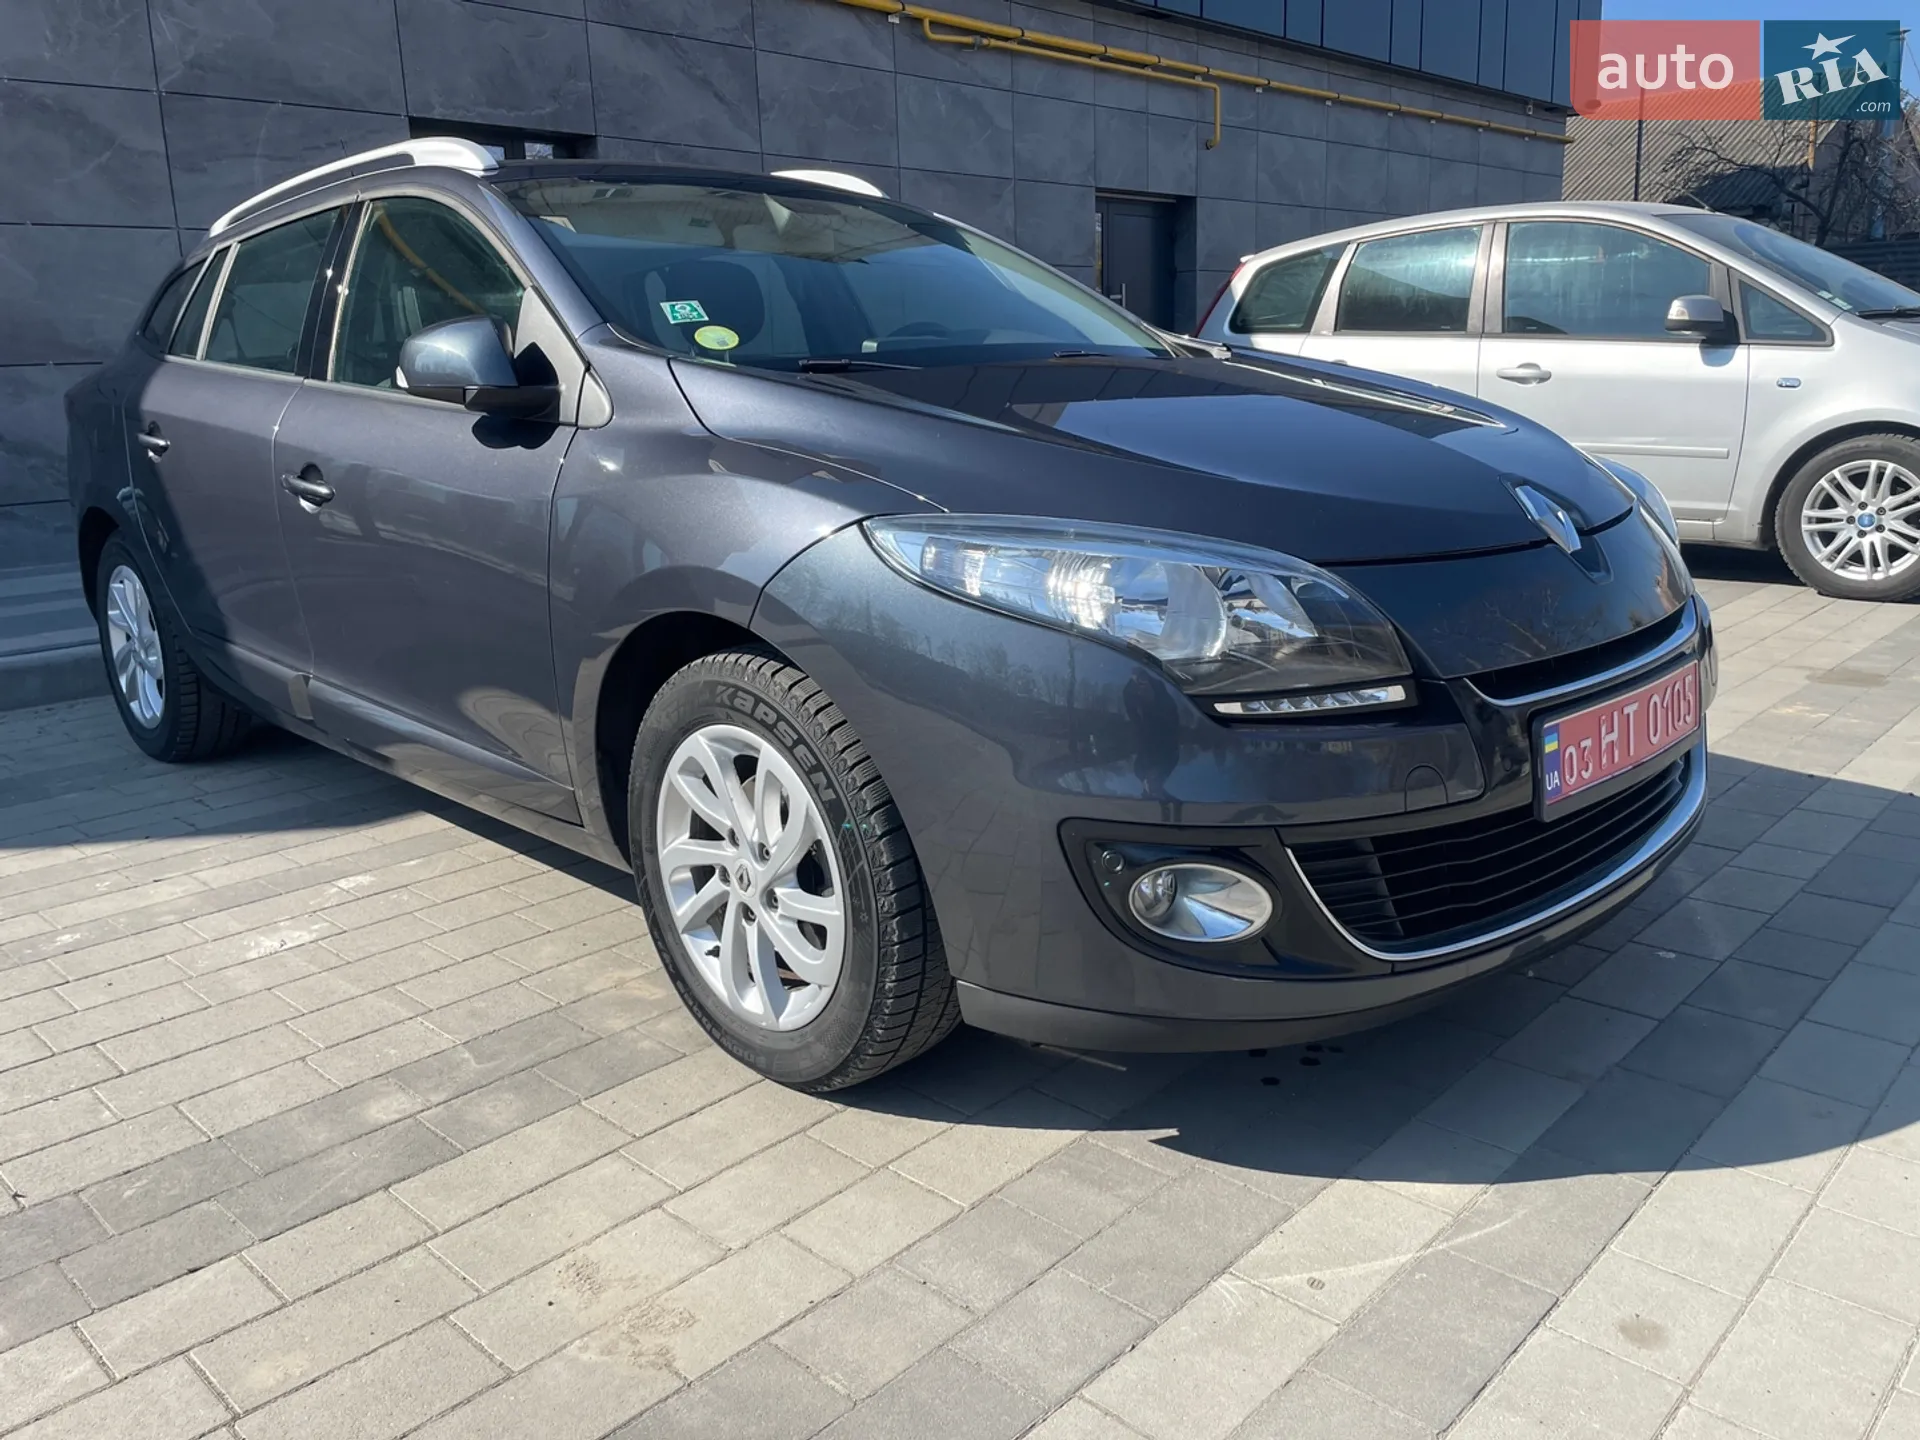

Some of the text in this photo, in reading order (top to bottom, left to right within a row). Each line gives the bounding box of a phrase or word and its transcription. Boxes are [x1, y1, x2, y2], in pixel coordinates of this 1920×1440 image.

[1564, 674, 1693, 786] 03 HT 0105
[1545, 771, 1560, 791] UA
